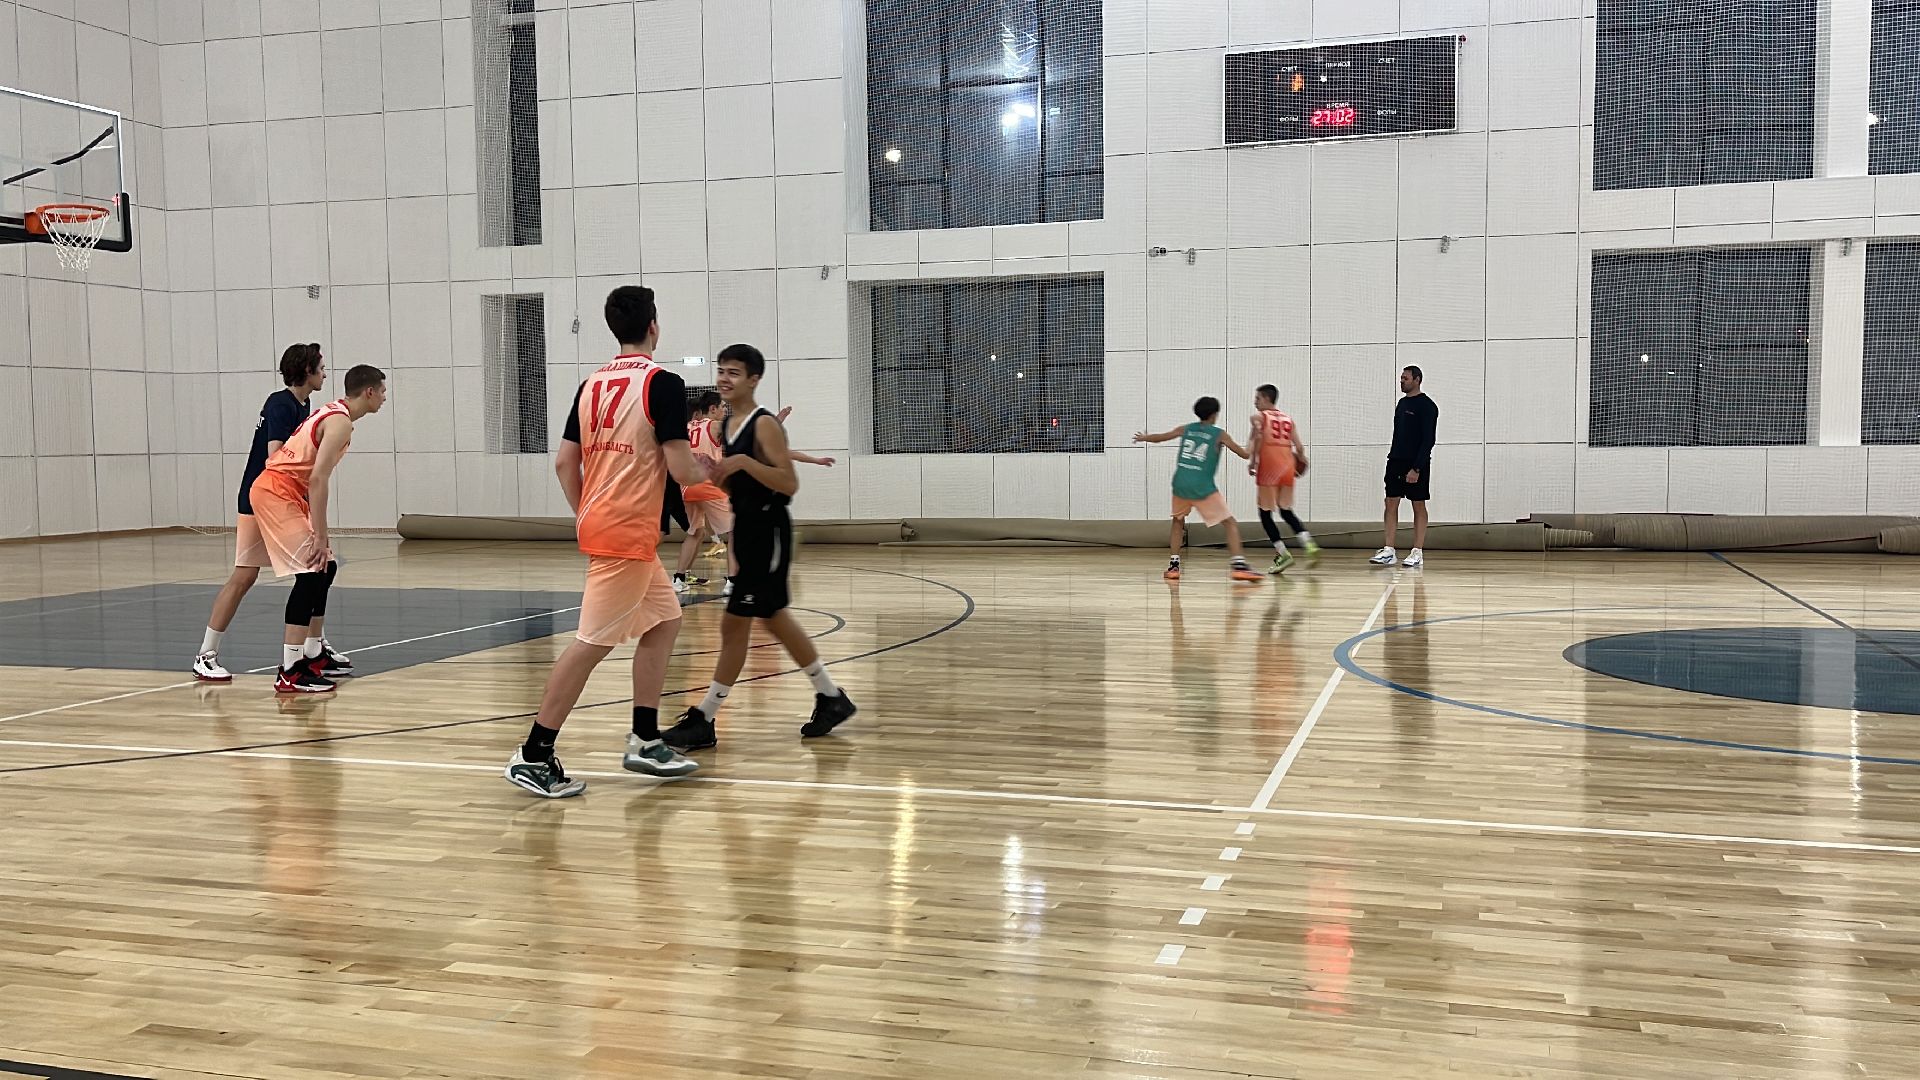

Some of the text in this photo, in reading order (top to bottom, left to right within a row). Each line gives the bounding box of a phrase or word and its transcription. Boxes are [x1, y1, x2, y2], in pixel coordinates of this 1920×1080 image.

[590, 376, 631, 433] 17
[1271, 419, 1292, 439] 99
[1181, 438, 1209, 462] 24
